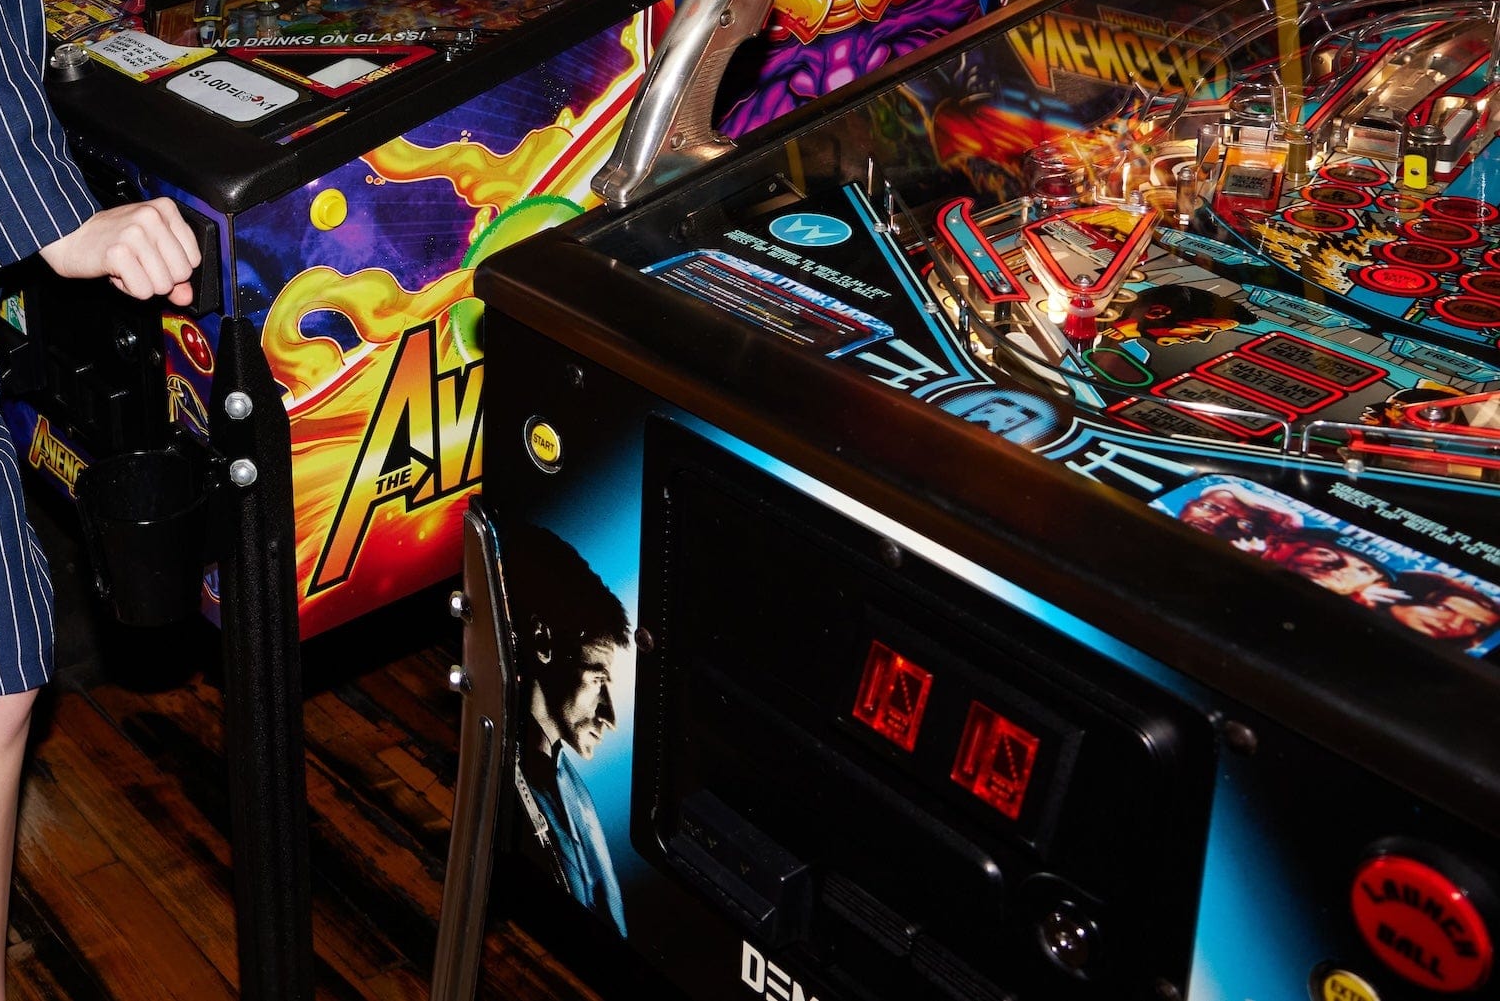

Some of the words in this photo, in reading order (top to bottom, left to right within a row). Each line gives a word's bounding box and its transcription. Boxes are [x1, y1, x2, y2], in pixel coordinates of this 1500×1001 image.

[212, 38, 241, 48] NO
[243, 35, 315, 47] DRINKS
[324, 34, 349, 44] ON
[353, 31, 427, 44] GLASS!
[722, 232, 749, 245] PRESS
[767, 251, 801, 267] BUTTON
[812, 270, 852, 289] RELEASE
[851, 287, 878, 300] BALL
[866, 286, 893, 298] LEFT
[1279, 299, 1324, 318] FREEZE
[1424, 350, 1476, 370] FREEZE
[1232, 362, 1321, 398] WASTELAND
[532, 433, 555, 453] START
[375, 467, 412, 495] THE
[1327, 488, 1370, 510] PRESS
[1374, 508, 1401, 521] TOP
[1402, 519, 1457, 546] BUTTON
[1460, 542, 1481, 555] TO
[1332, 481, 1391, 509] SQUEEZE
[1392, 506, 1449, 533] TRIGGER
[1451, 531, 1472, 543] TO
[1360, 877, 1481, 959] LAUNCH
[1376, 921, 1446, 982] BALL
